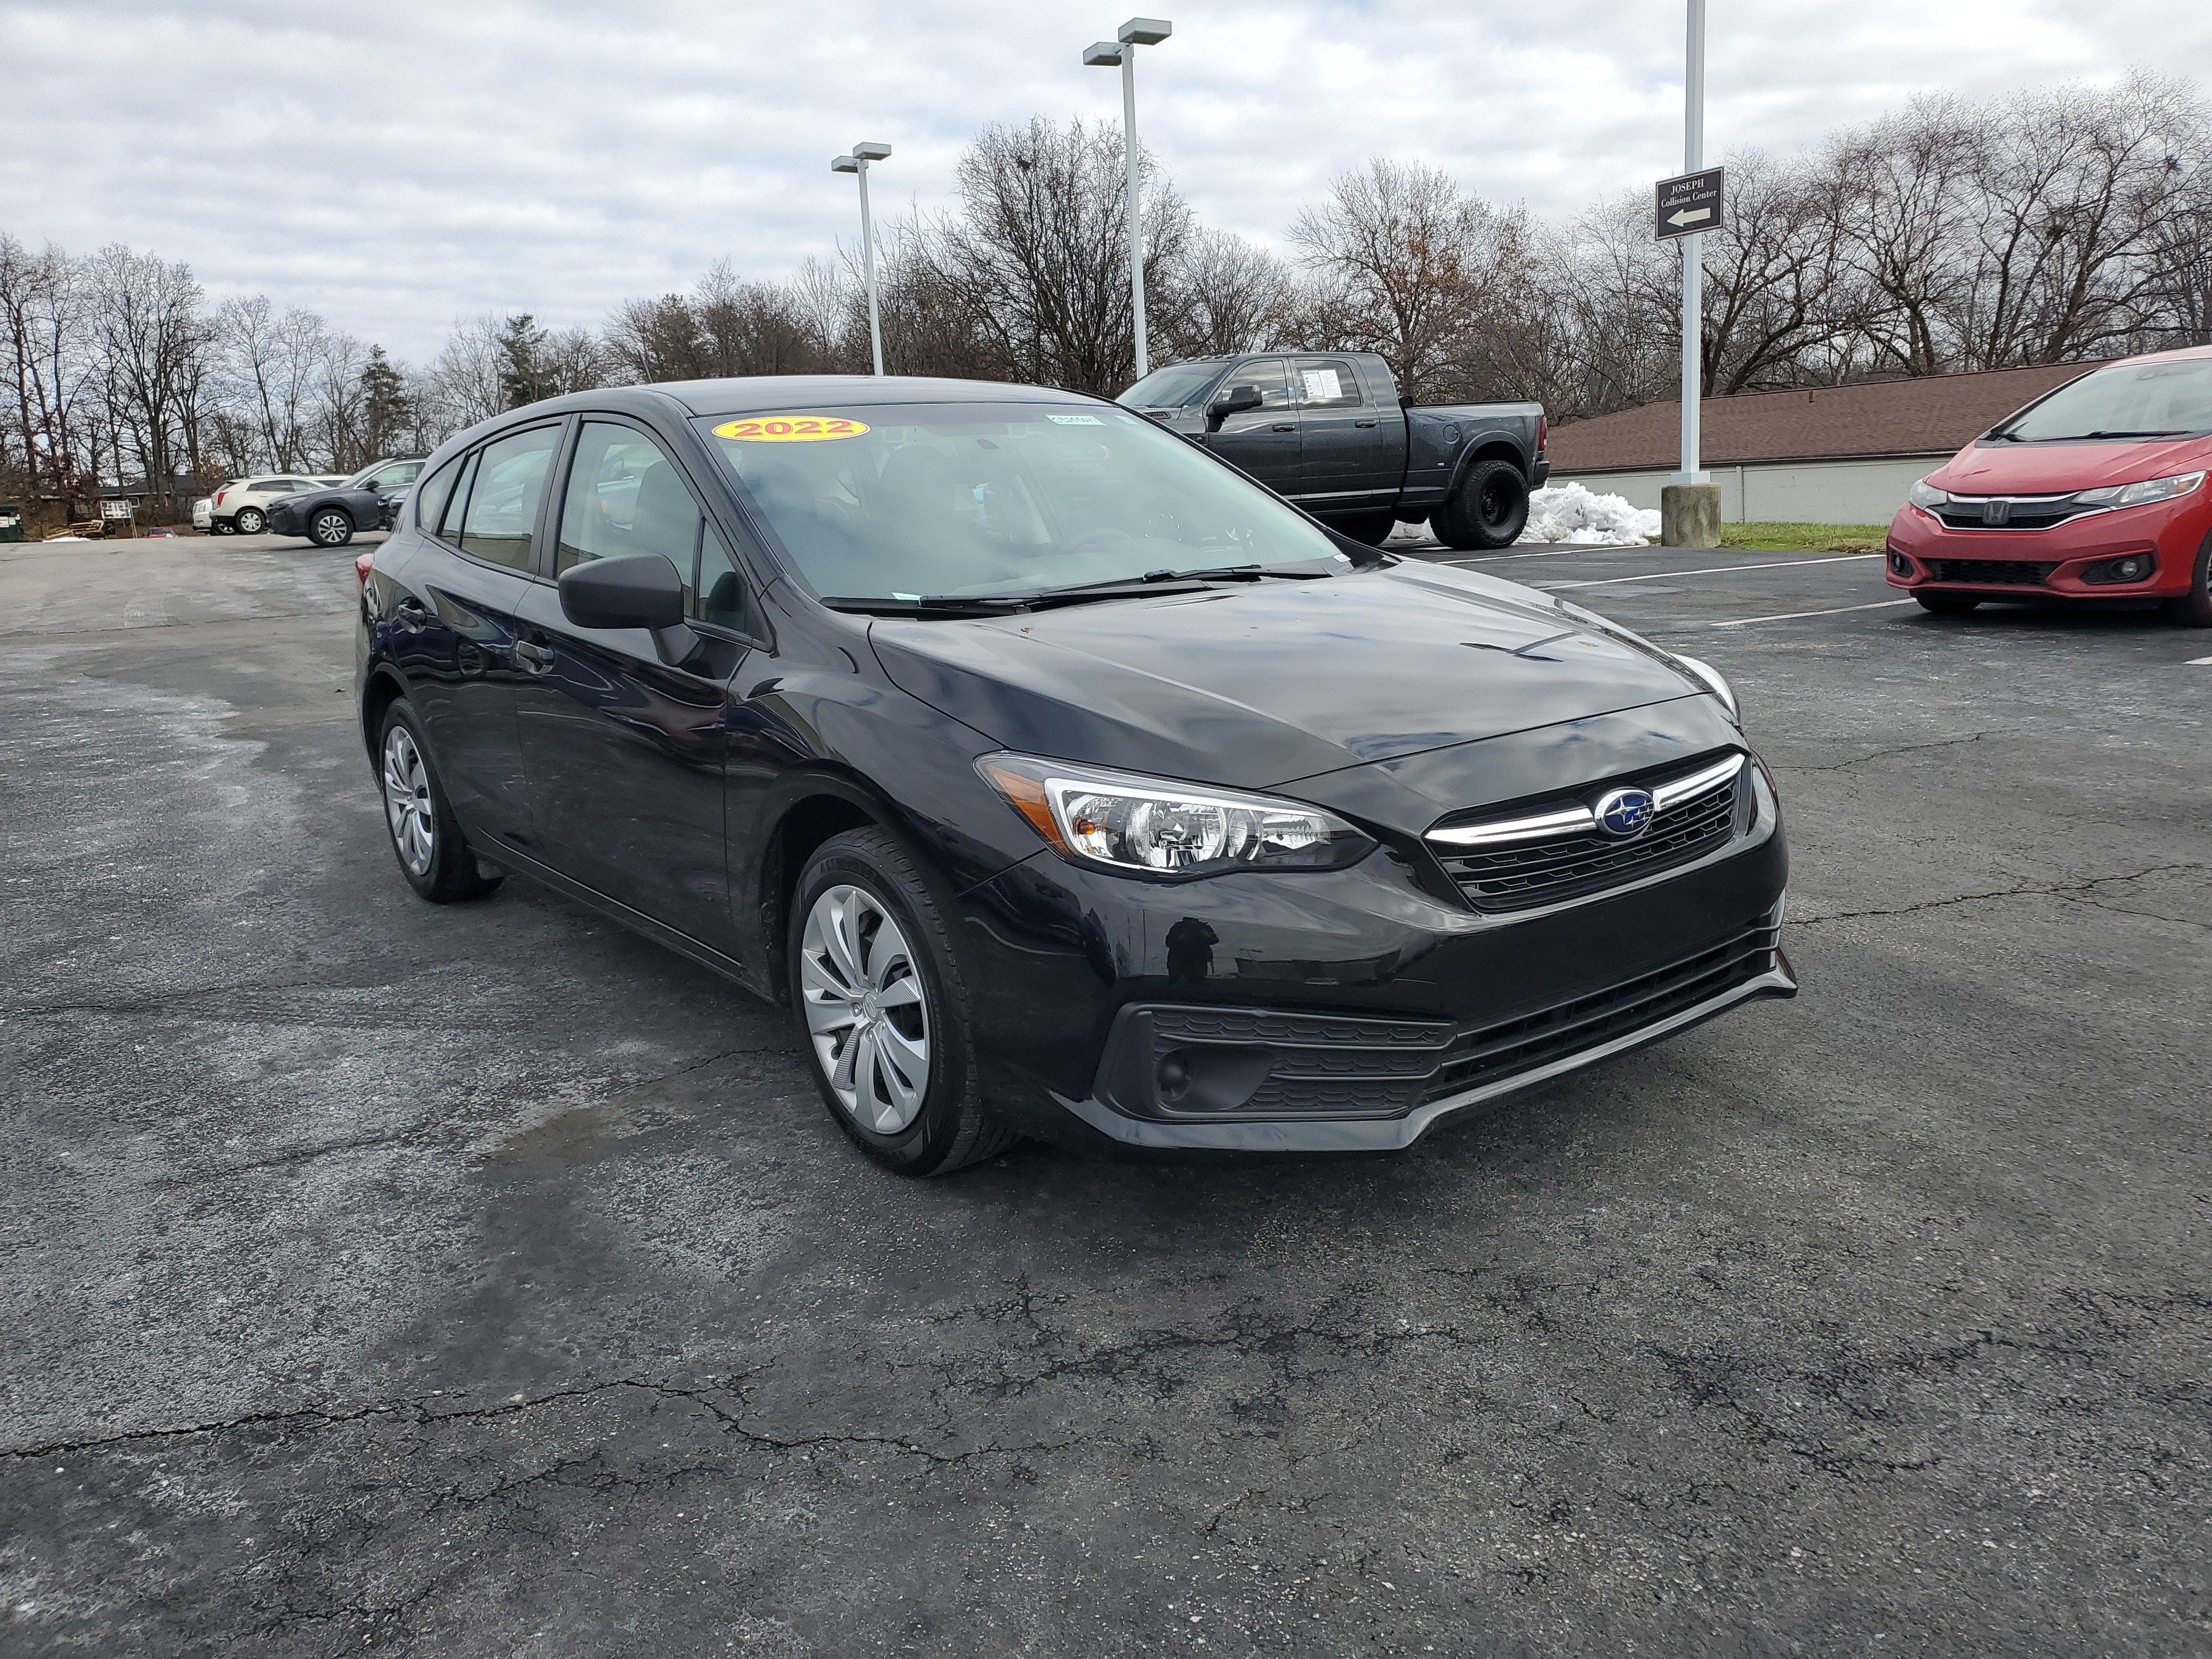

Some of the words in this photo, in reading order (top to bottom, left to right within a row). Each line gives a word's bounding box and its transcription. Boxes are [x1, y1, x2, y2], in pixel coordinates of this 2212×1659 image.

[1671, 178, 1704, 195] JOSEPH
[1661, 195, 1691, 208] Collision
[1692, 190, 1717, 201] Center
[734, 421, 855, 437] 2022
